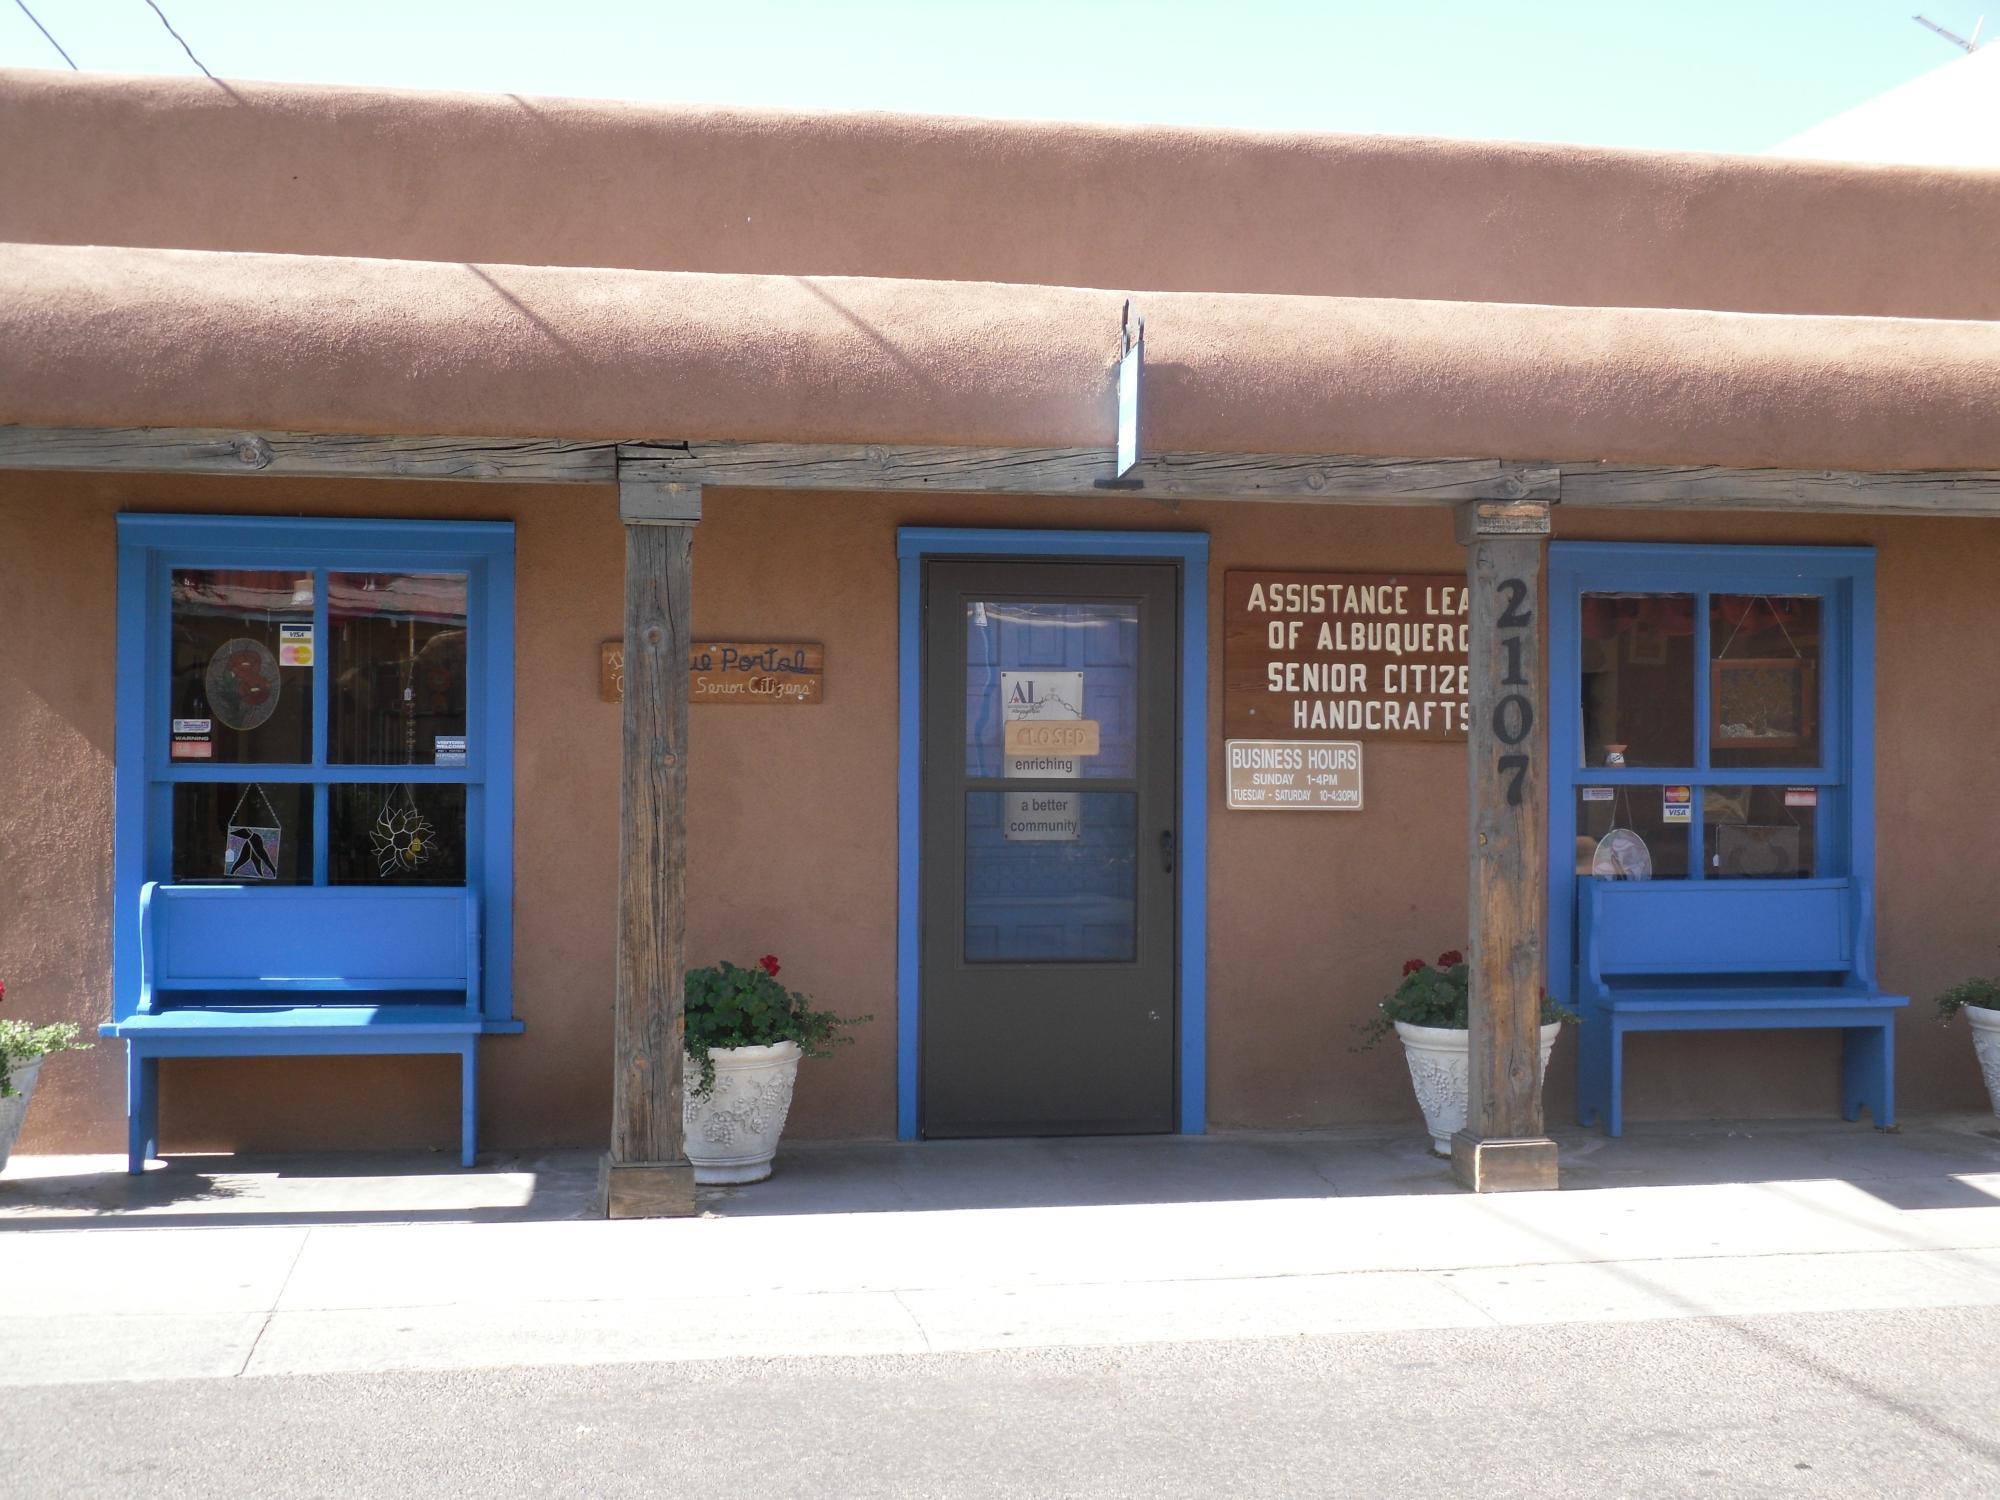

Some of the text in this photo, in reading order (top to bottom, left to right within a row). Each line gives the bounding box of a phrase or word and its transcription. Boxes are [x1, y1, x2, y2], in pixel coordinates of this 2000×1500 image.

[1247, 583, 1409, 615] ASSISTANCE
[1268, 621, 1304, 650] OF
[721, 648, 809, 674] Portal
[695, 676, 748, 694] Senior
[1267, 662, 1469, 695] SENIOR CITIZE
[1492, 577, 1534, 807] 2107
[1016, 727, 1088, 746] CLOSED
[1015, 757, 1073, 773] enriching
[1232, 748, 1357, 770] BUSINESS HOURS
[1252, 773, 1338, 785] SUNDAY 1-4PM
[1021, 799, 1068, 811] a better
[1233, 789, 1266, 801] TUESDAY
[1274, 789, 1311, 801] SATURDAY
[1319, 790, 1358, 802] 10-4:30PM
[1010, 818, 1078, 834] community
